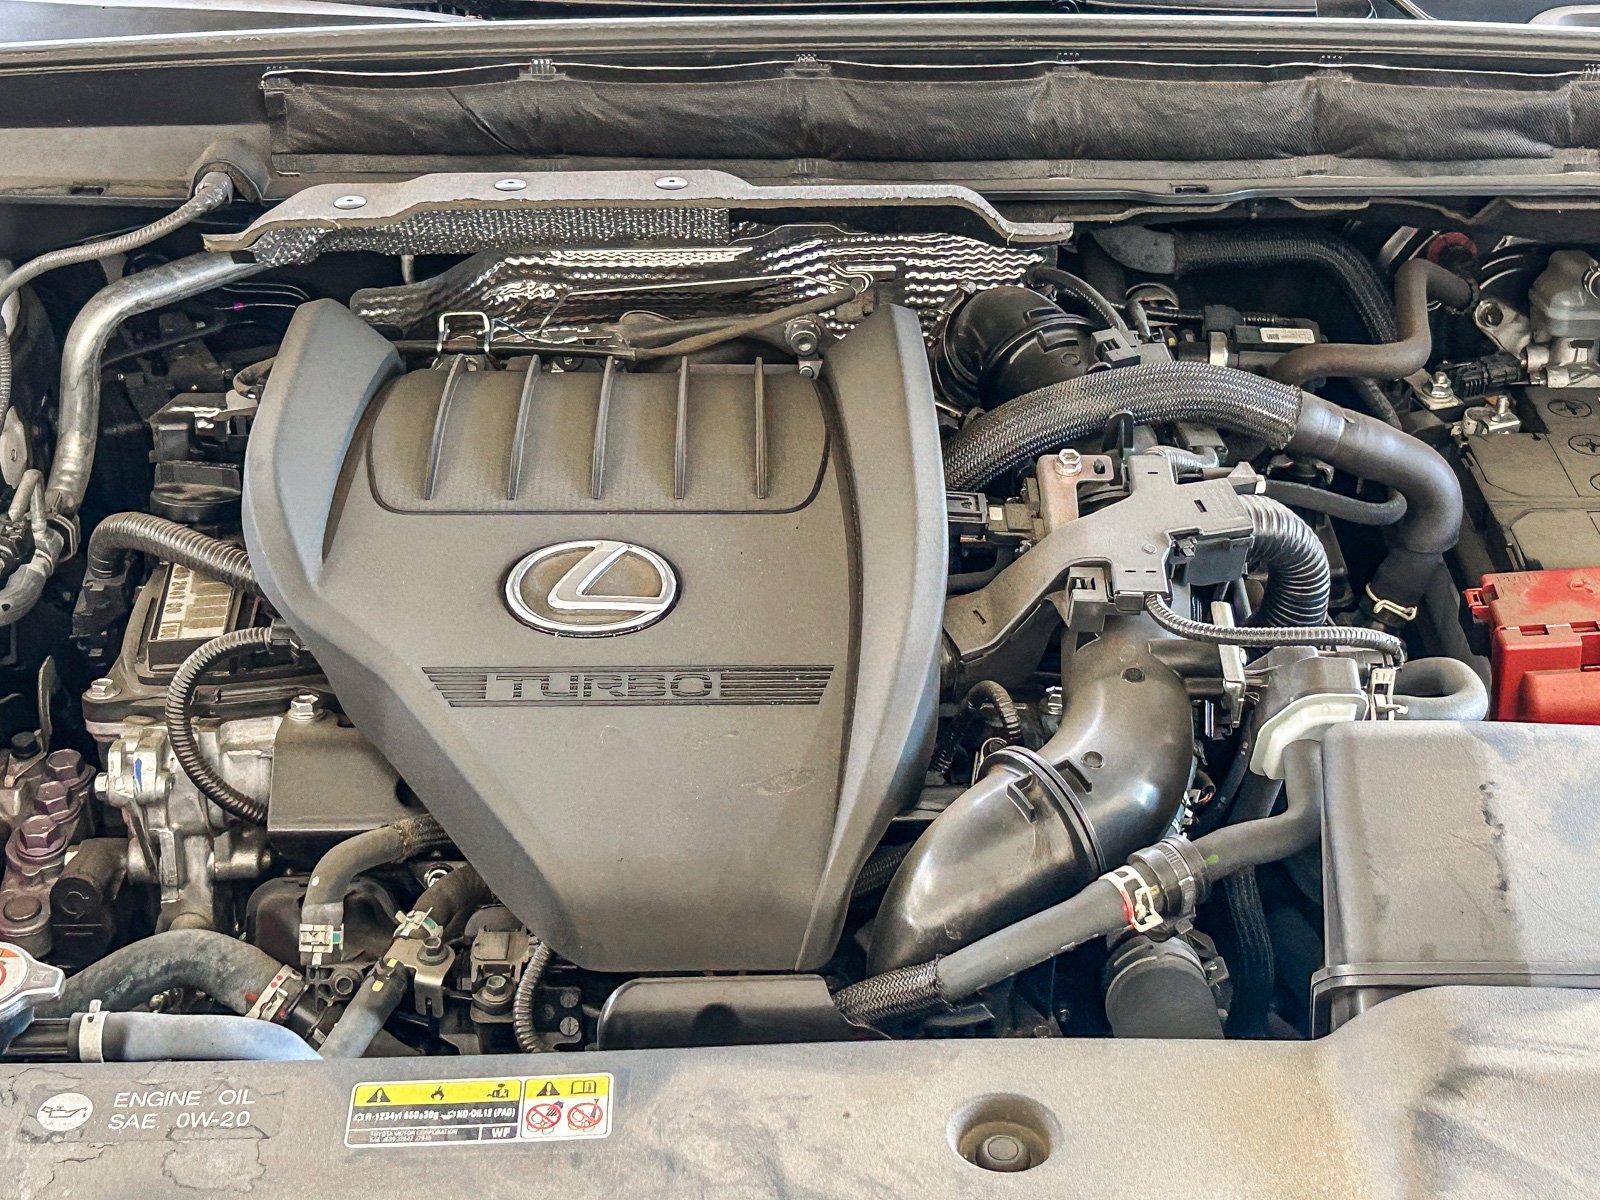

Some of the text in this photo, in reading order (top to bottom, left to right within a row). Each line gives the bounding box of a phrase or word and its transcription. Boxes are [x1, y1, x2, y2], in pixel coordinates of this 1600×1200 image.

[496, 674, 713, 698] TURBO
[218, 1089, 256, 1105] OIL
[176, 1111, 251, 1128] 0W-20
